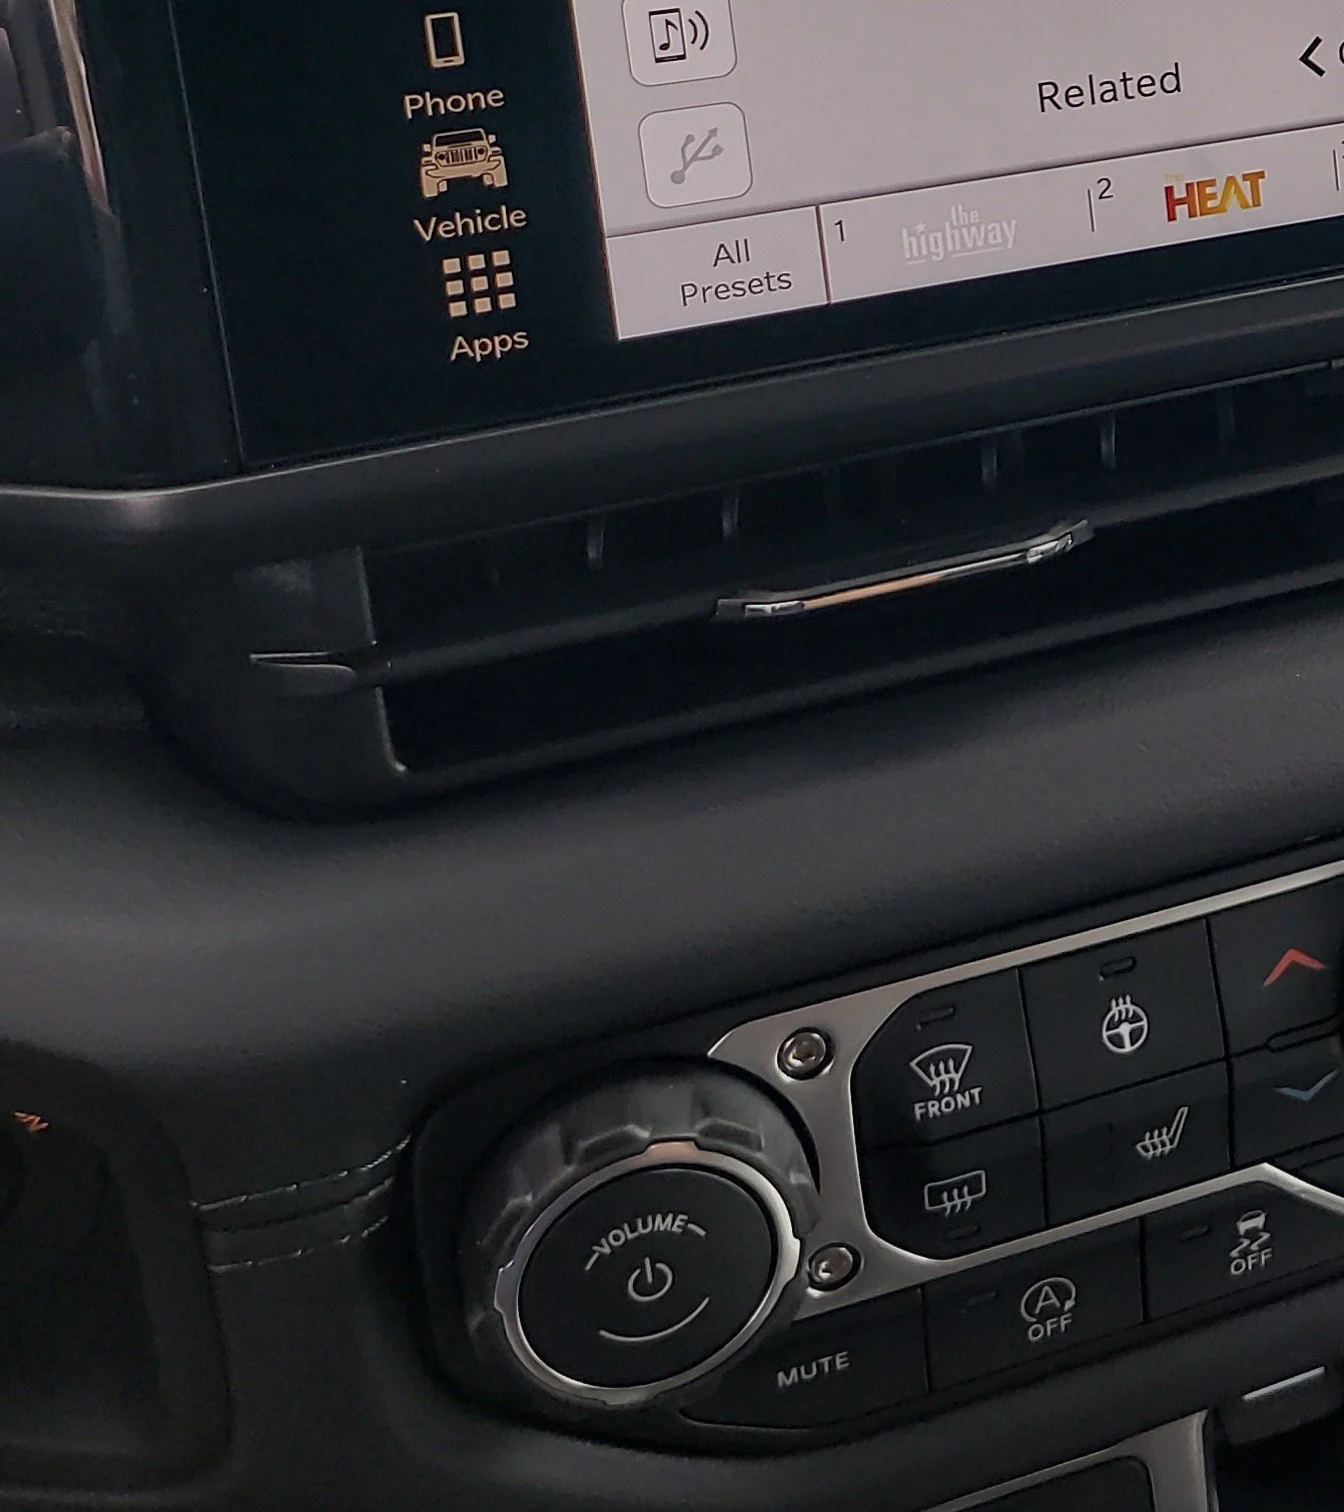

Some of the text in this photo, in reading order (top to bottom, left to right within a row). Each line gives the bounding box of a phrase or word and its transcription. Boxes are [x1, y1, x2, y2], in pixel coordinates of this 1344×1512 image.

[403, 86, 506, 120] Phone
[1038, 61, 1183, 114] Related
[1097, 177, 1114, 200] 2
[1164, 170, 1267, 223] HEAT
[413, 204, 527, 243] Vehicle
[834, 219, 846, 243] 1
[950, 203, 981, 226] the
[712, 238, 752, 268] All
[901, 219, 1017, 262] highway
[680, 268, 794, 308] Presets
[449, 328, 530, 363] Apps
[914, 1086, 984, 1122] FRONT
[592, 1212, 689, 1258] VOLUME
[1230, 1247, 1274, 1277] OFF
[1027, 1313, 1074, 1344] OFF
[777, 1351, 852, 1389] MUTE
